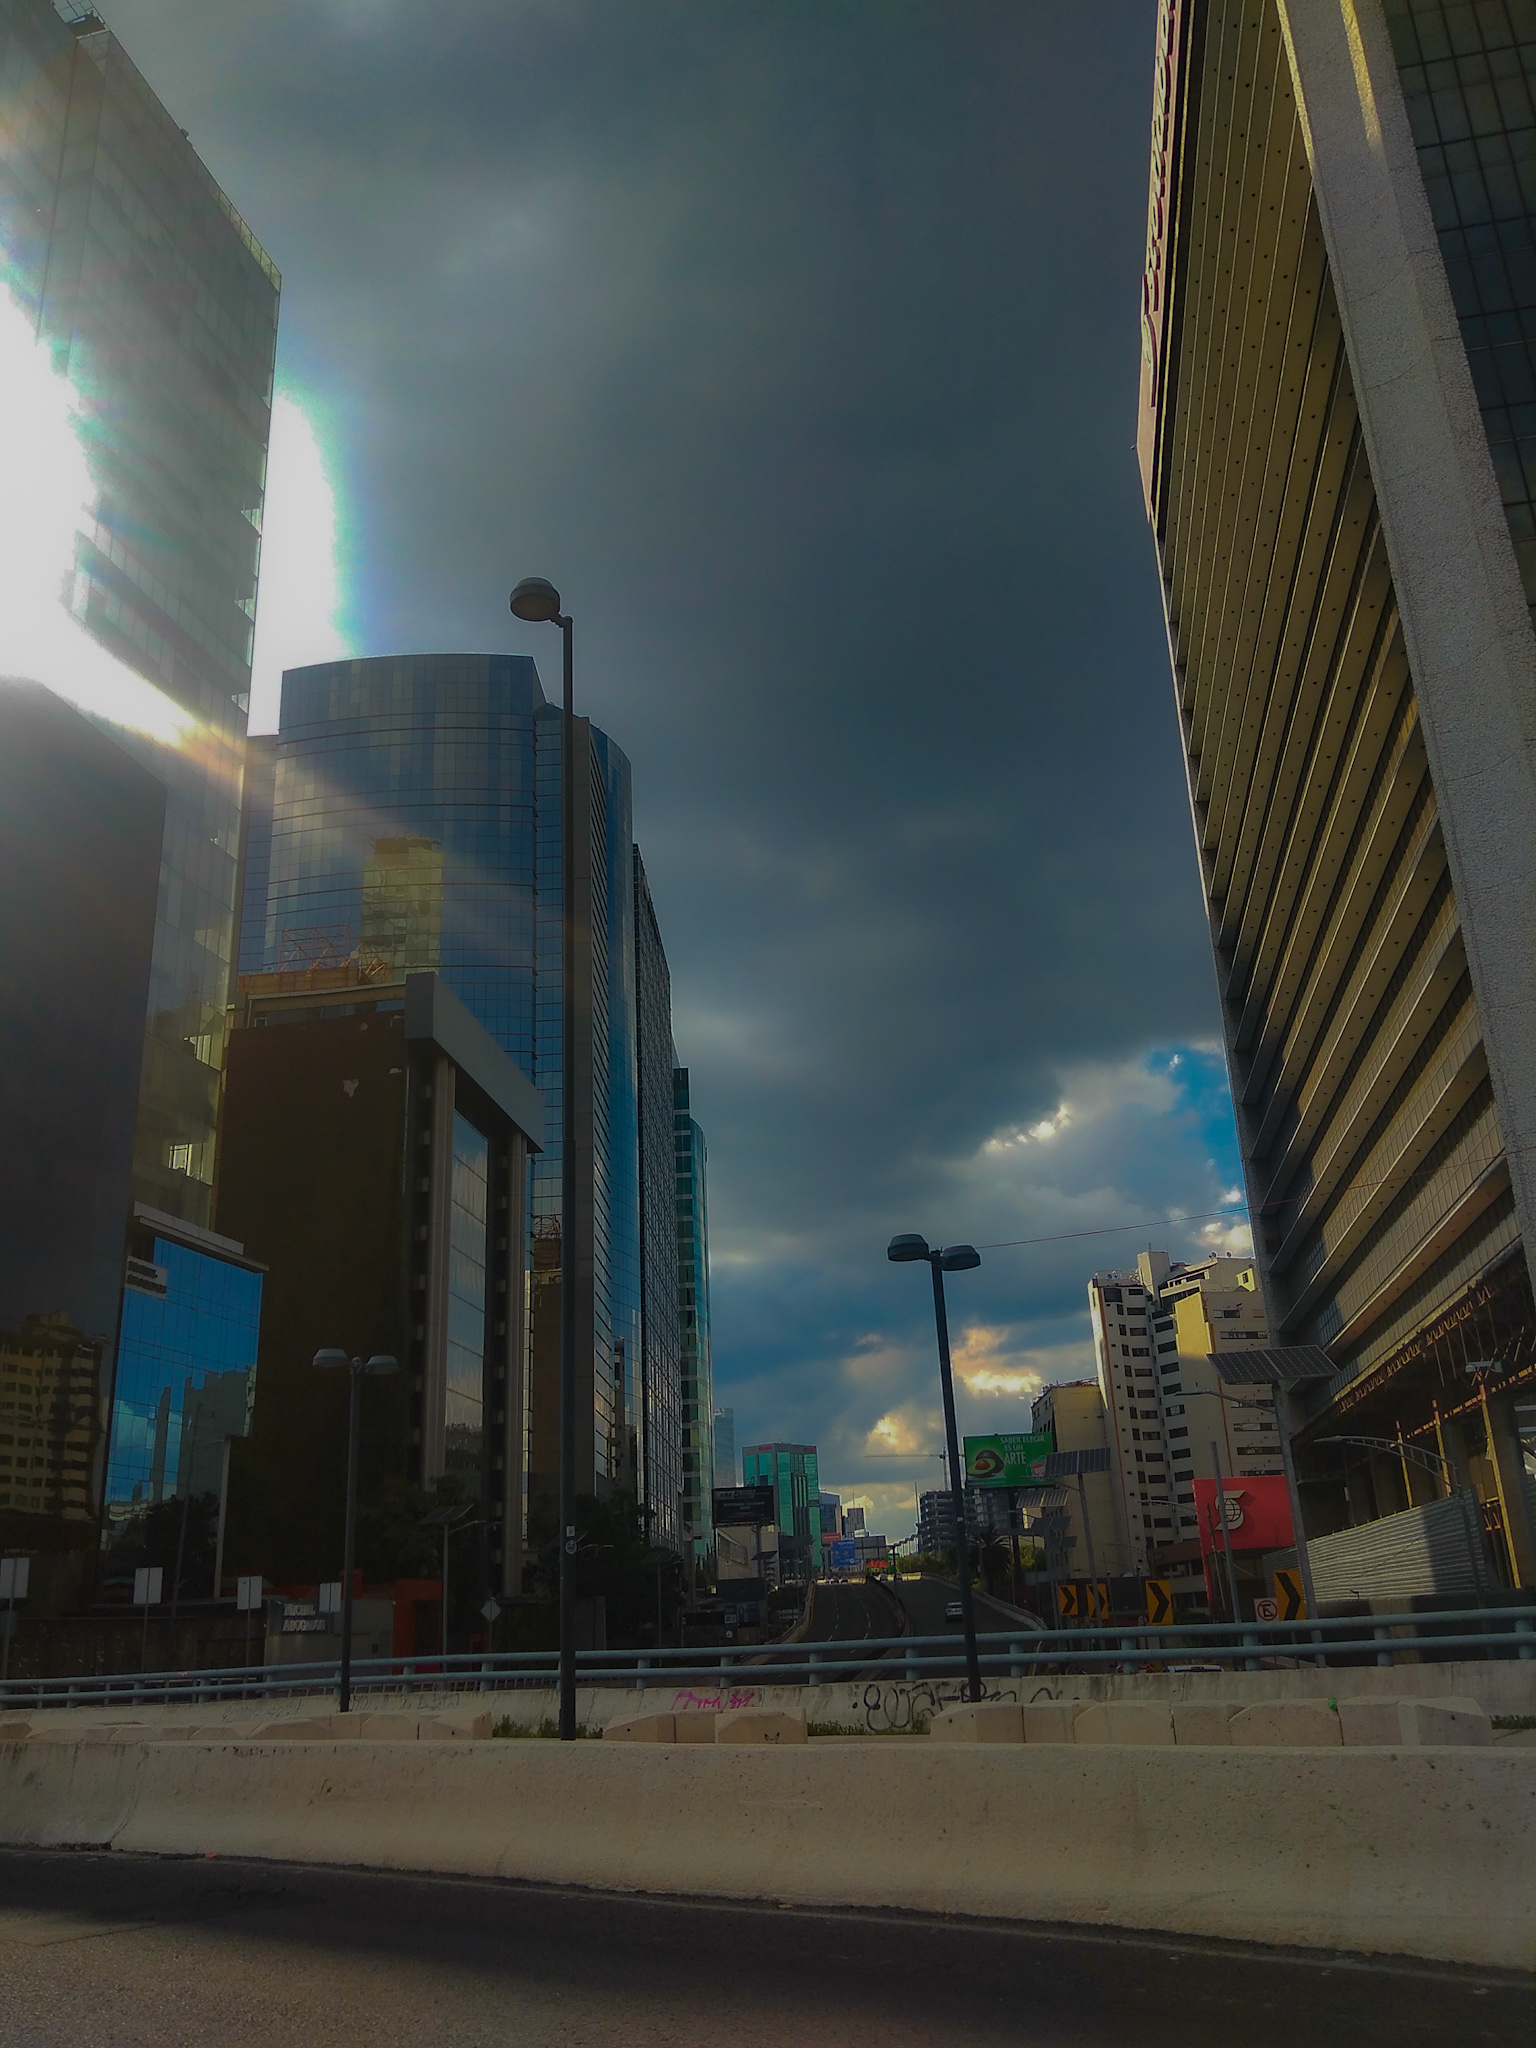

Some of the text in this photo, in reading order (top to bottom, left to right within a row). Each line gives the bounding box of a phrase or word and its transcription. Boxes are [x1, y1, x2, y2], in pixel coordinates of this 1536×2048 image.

[1147, 0, 1176, 312] Scotiaba
[1000, 1435, 1045, 1444] SABER ELEGIR
[1004, 1452, 1027, 1464] ARTE
